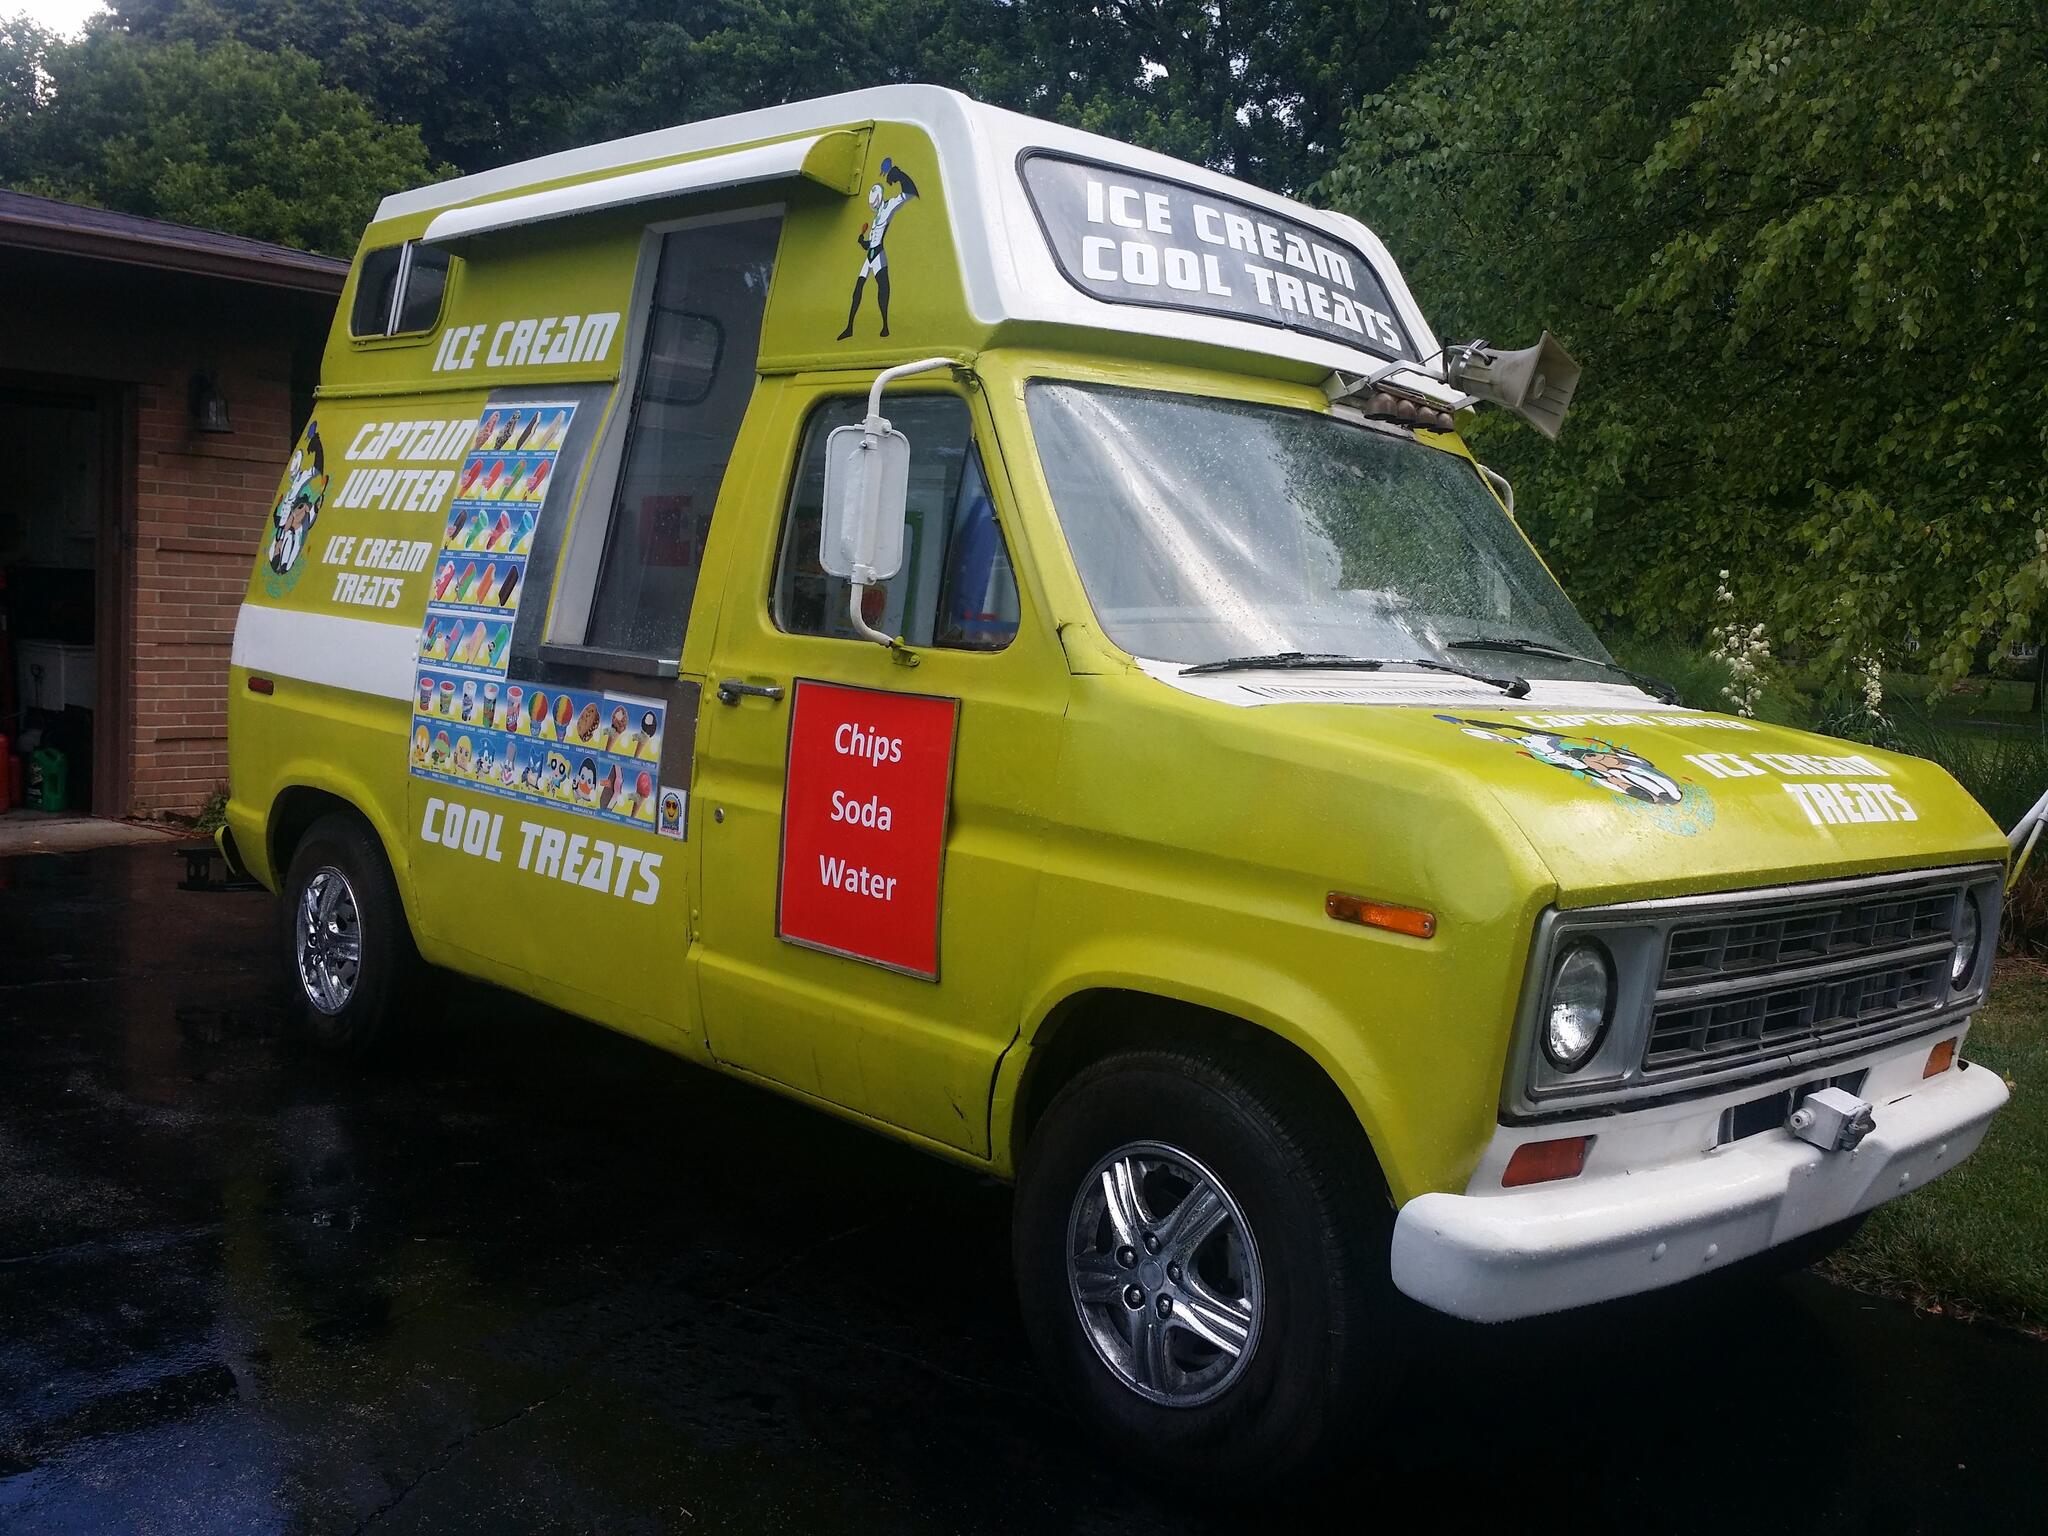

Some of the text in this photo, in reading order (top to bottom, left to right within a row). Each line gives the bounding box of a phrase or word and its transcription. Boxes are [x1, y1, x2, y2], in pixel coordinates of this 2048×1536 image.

[1086, 180, 1357, 292] ICE CREAM
[1081, 235, 1403, 353] COOL TREATS
[431, 311, 622, 373] ICE CREAM
[343, 418, 480, 462] CAPTAIN
[331, 468, 457, 513] JUPITER
[321, 535, 433, 573] ICE CREAM
[331, 572, 405, 609] TREATS
[834, 722, 903, 767] Chips
[1683, 752, 1891, 780] ICE CREAM
[829, 790, 893, 831] Soda
[1781, 782, 1920, 826] TREATS
[420, 797, 664, 905] COOL TREATS
[818, 854, 898, 901] Water
